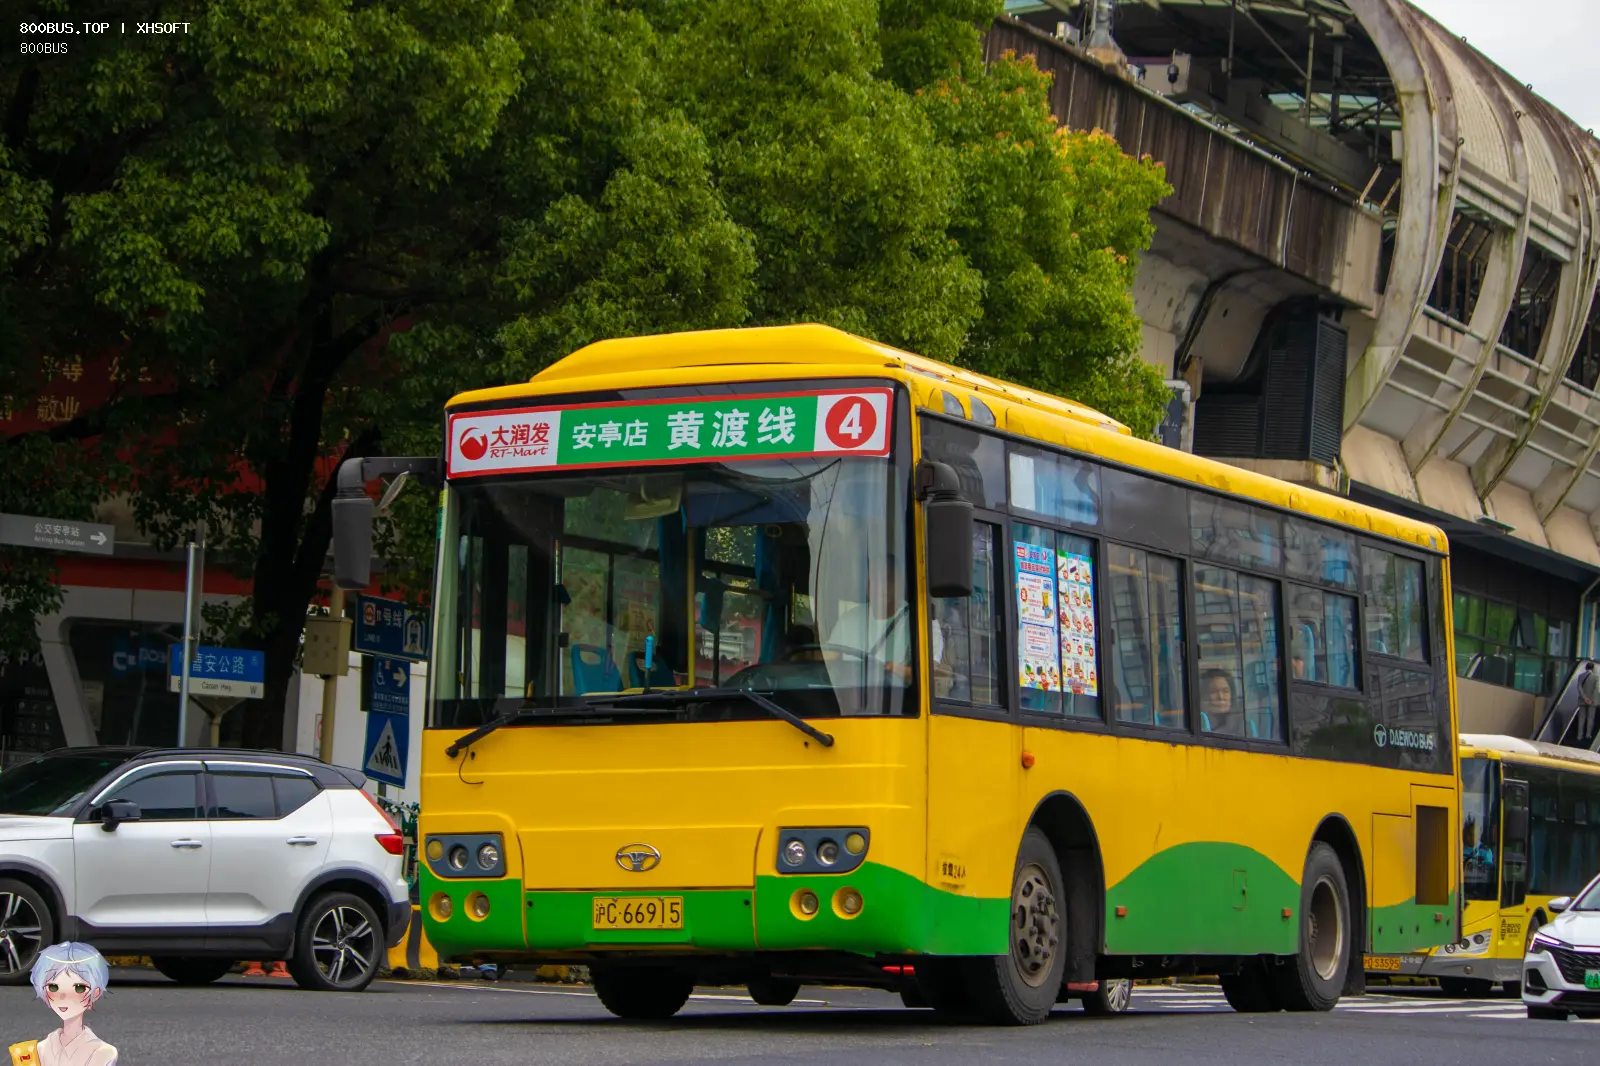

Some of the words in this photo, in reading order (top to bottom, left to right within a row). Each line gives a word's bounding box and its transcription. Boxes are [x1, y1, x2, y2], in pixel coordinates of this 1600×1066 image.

[36, 395, 80, 423] 敬业
[572, 419, 649, 450] 安亭店
[666, 405, 797, 451] 黄渡线
[838, 402, 864, 440] 4
[490, 422, 550, 447] 大润发
[490, 446, 549, 459] RT-Mart
[34, 522, 80, 537] 公交安亭站
[192, 652, 244, 675] 曹安公路
[250, 685, 257, 695] W
[1389, 728, 1418, 748] DAEWOO
[1419, 732, 1434, 750] BUS
